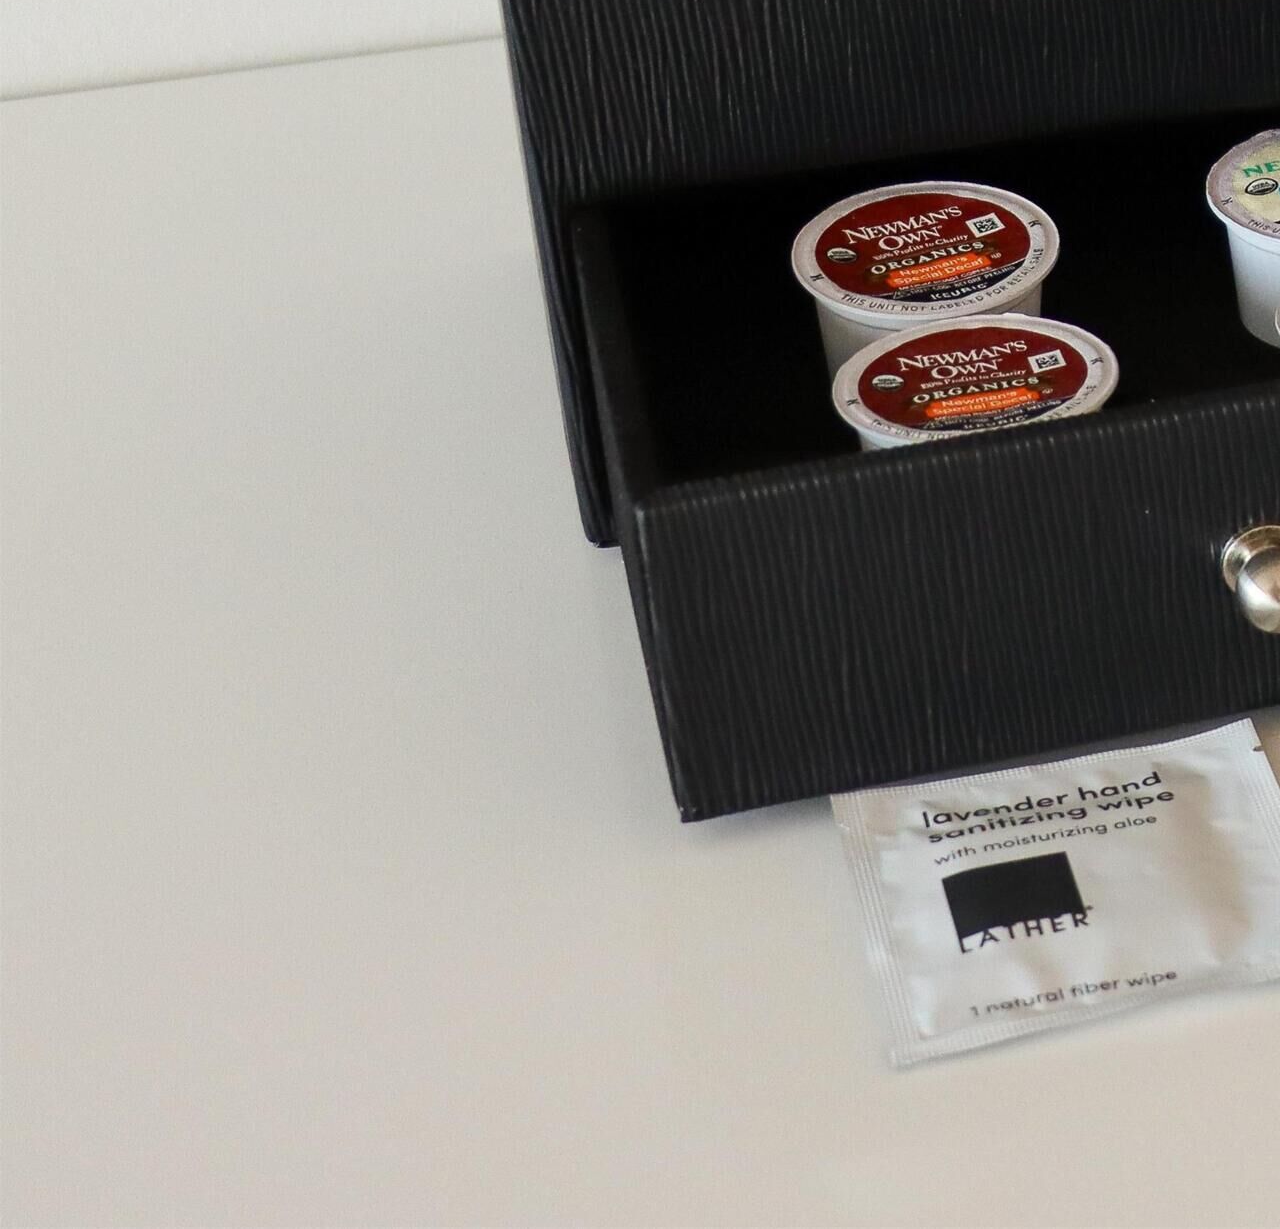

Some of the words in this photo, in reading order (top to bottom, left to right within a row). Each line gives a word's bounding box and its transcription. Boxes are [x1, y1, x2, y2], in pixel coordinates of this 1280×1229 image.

[842, 205, 963, 244] NEWMAN'S
[879, 226, 941, 251] OWN
[1248, 218, 1270, 231] THIS
[871, 241, 985, 275] ORGANICS
[894, 240, 923, 257] Profits
[934, 234, 969, 246] Charity
[893, 268, 942, 285] Special
[948, 257, 984, 274] Decaf
[900, 256, 968, 277] Newman's
[841, 293, 867, 306] THIS
[868, 301, 897, 311] UNIT
[931, 294, 984, 311] LABELED
[987, 283, 1009, 298] FOR
[931, 281, 987, 300] KEURIG
[897, 340, 1028, 371] NEWMAN'S
[931, 359, 999, 379] OWN
[990, 369, 1027, 379] Charity
[912, 377, 1040, 404] ORGANICS
[941, 391, 1018, 408] Newman's
[922, 791, 1070, 829] lavender
[1077, 770, 1164, 802] hand
[927, 797, 1088, 844] sanitizing
[1096, 789, 1176, 814] wipe
[934, 844, 977, 867] with
[983, 820, 1109, 851] moisturizing
[1113, 814, 1158, 831] aloe
[957, 911, 1091, 954] LATHER
[969, 1005, 980, 1018] 1
[986, 987, 1066, 1016] natural
[1070, 977, 1120, 998] fiber
[1127, 969, 1179, 991] wipe
